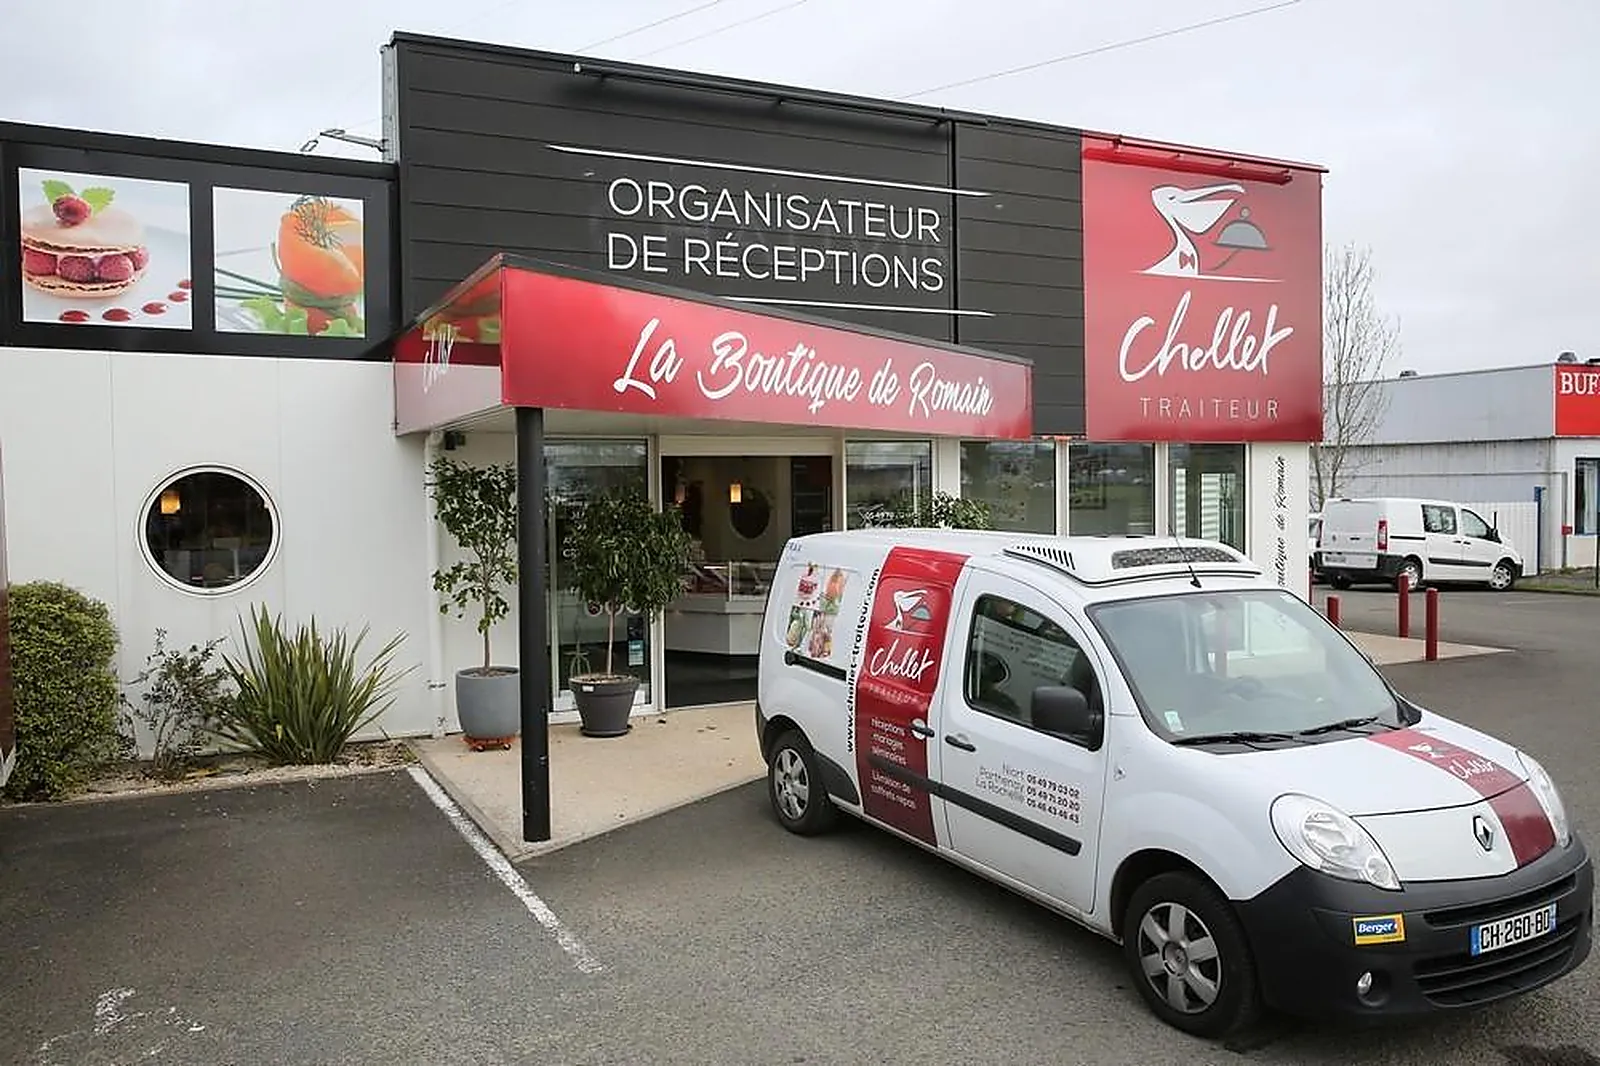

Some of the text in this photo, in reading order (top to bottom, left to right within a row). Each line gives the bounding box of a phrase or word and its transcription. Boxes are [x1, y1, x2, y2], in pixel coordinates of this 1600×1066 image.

[608, 178, 941, 242] ORGANISATEUR
[608, 232, 944, 292] DE RÉCEPTIONS
[1119, 290, 1294, 382] Chollet
[613, 318, 995, 418] La Boutique de Romain
[1560, 372, 1600, 395] BUF
[1140, 397, 1279, 419] TRAITEUR
[1274, 455, 1288, 587] outique de Romain
[846, 568, 880, 753] www.chollet-traiteur.com
[870, 638, 935, 683] Chollet
[1026, 774, 1036, 784] 05
[1026, 786, 1036, 796] 05
[1026, 798, 1036, 807] 05
[1358, 922, 1393, 934] Berger
